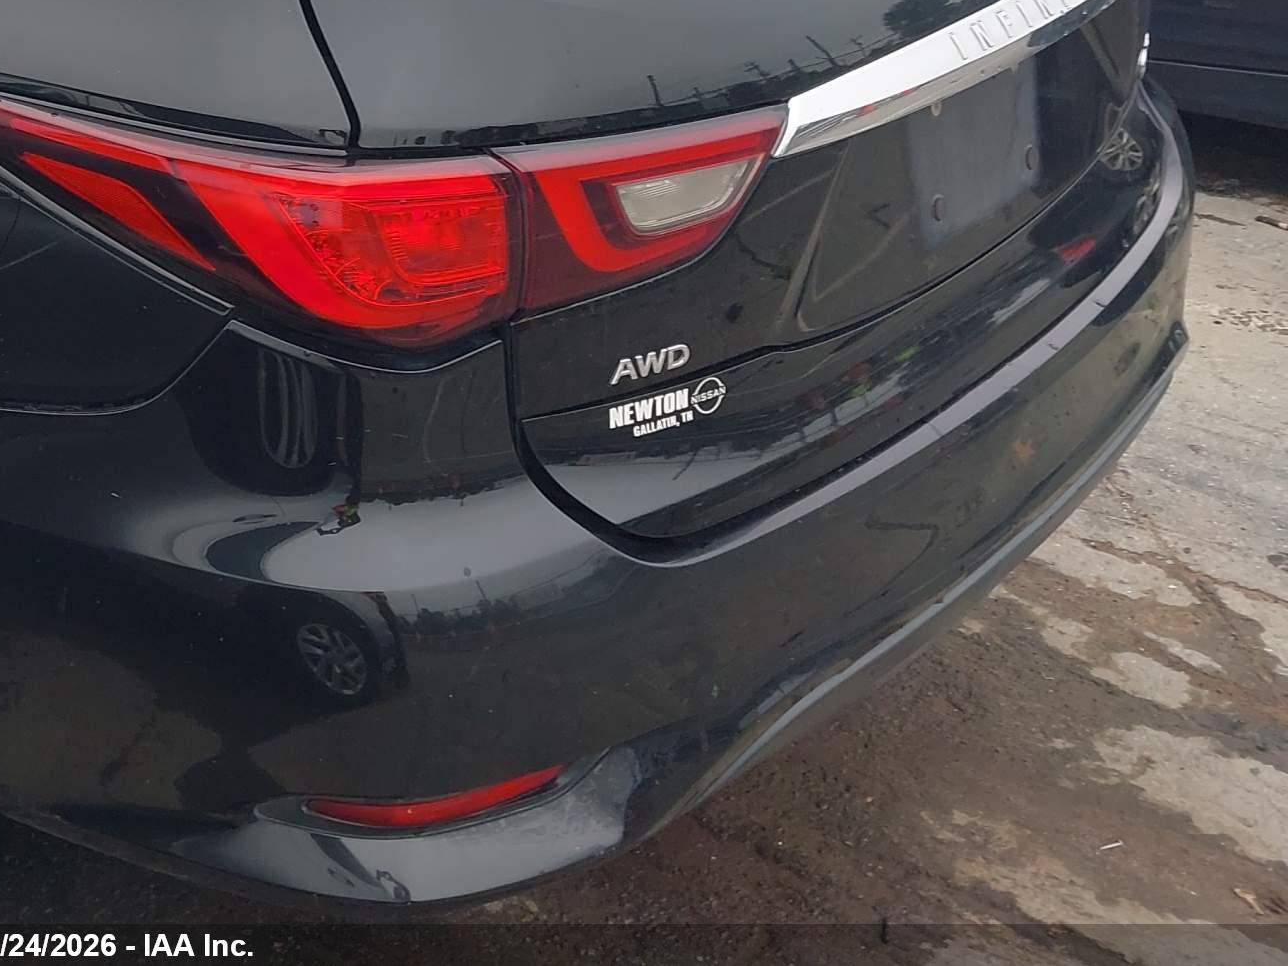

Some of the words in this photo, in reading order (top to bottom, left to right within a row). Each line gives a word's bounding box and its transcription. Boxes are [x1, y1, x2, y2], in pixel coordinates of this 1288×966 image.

[609, 344, 691, 385] AWD
[609, 388, 689, 429] NEWTON
[691, 385, 727, 405] NISSAN
